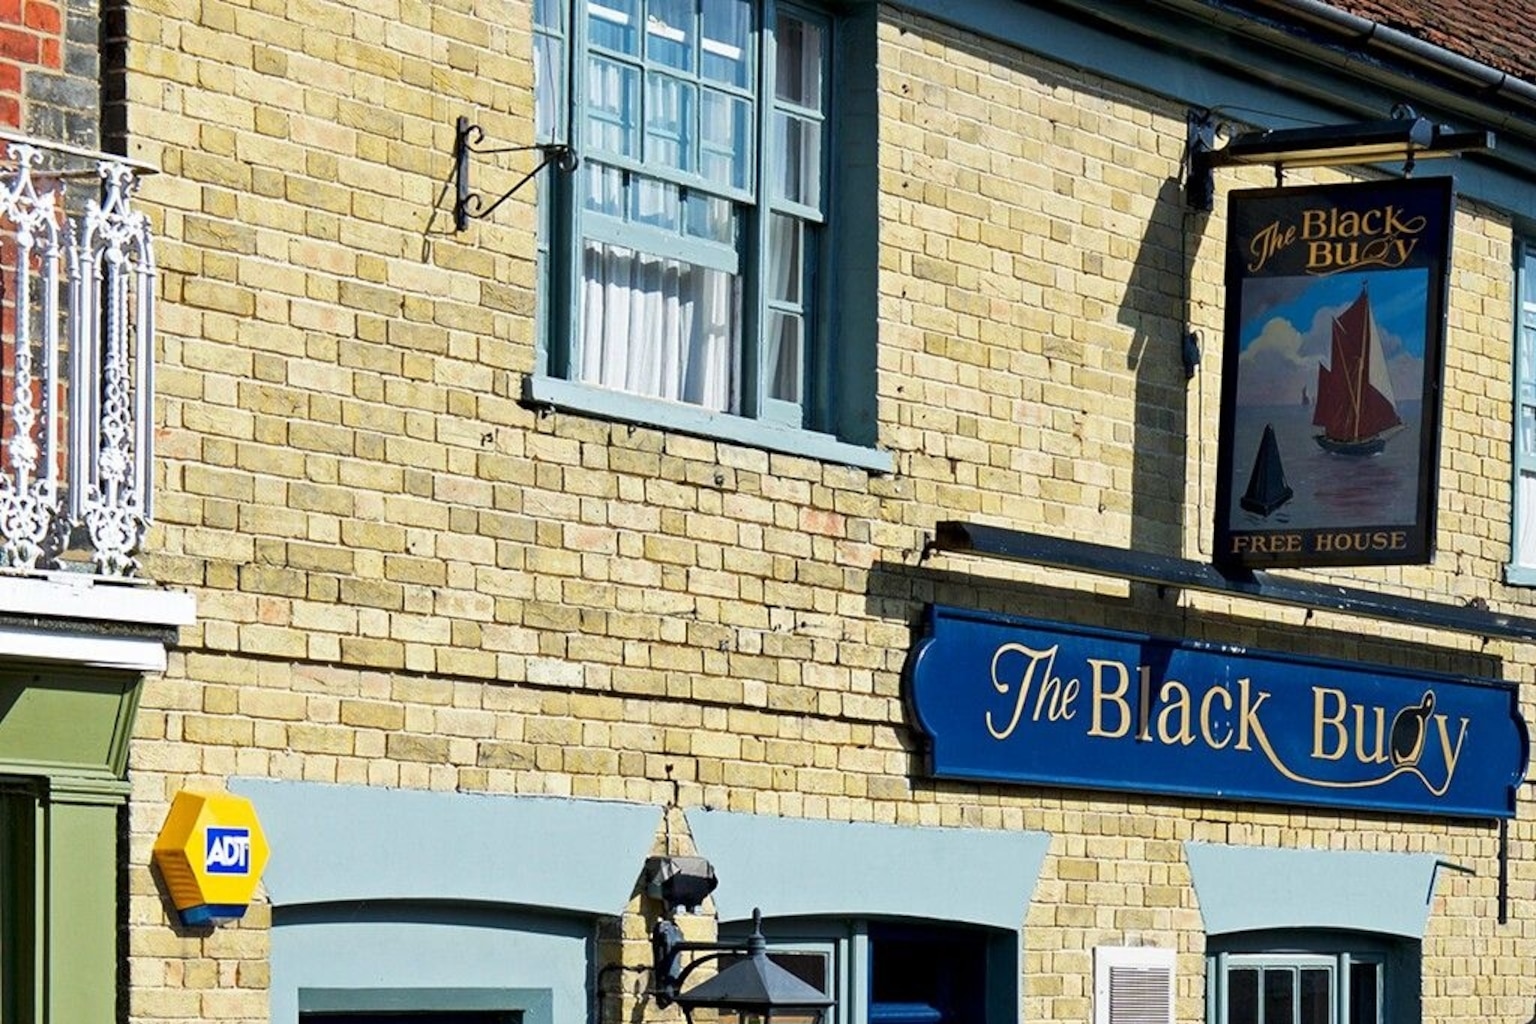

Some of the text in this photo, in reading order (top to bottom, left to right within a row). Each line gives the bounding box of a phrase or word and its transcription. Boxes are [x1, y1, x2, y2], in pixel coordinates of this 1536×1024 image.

[1248, 205, 1427, 273] The Black
[1305, 237, 1418, 277] Buoy
[1231, 531, 1407, 554] FREE HOUSE
[986, 642, 1470, 796] The Black Buoy
[207, 836, 250, 867] ADT
